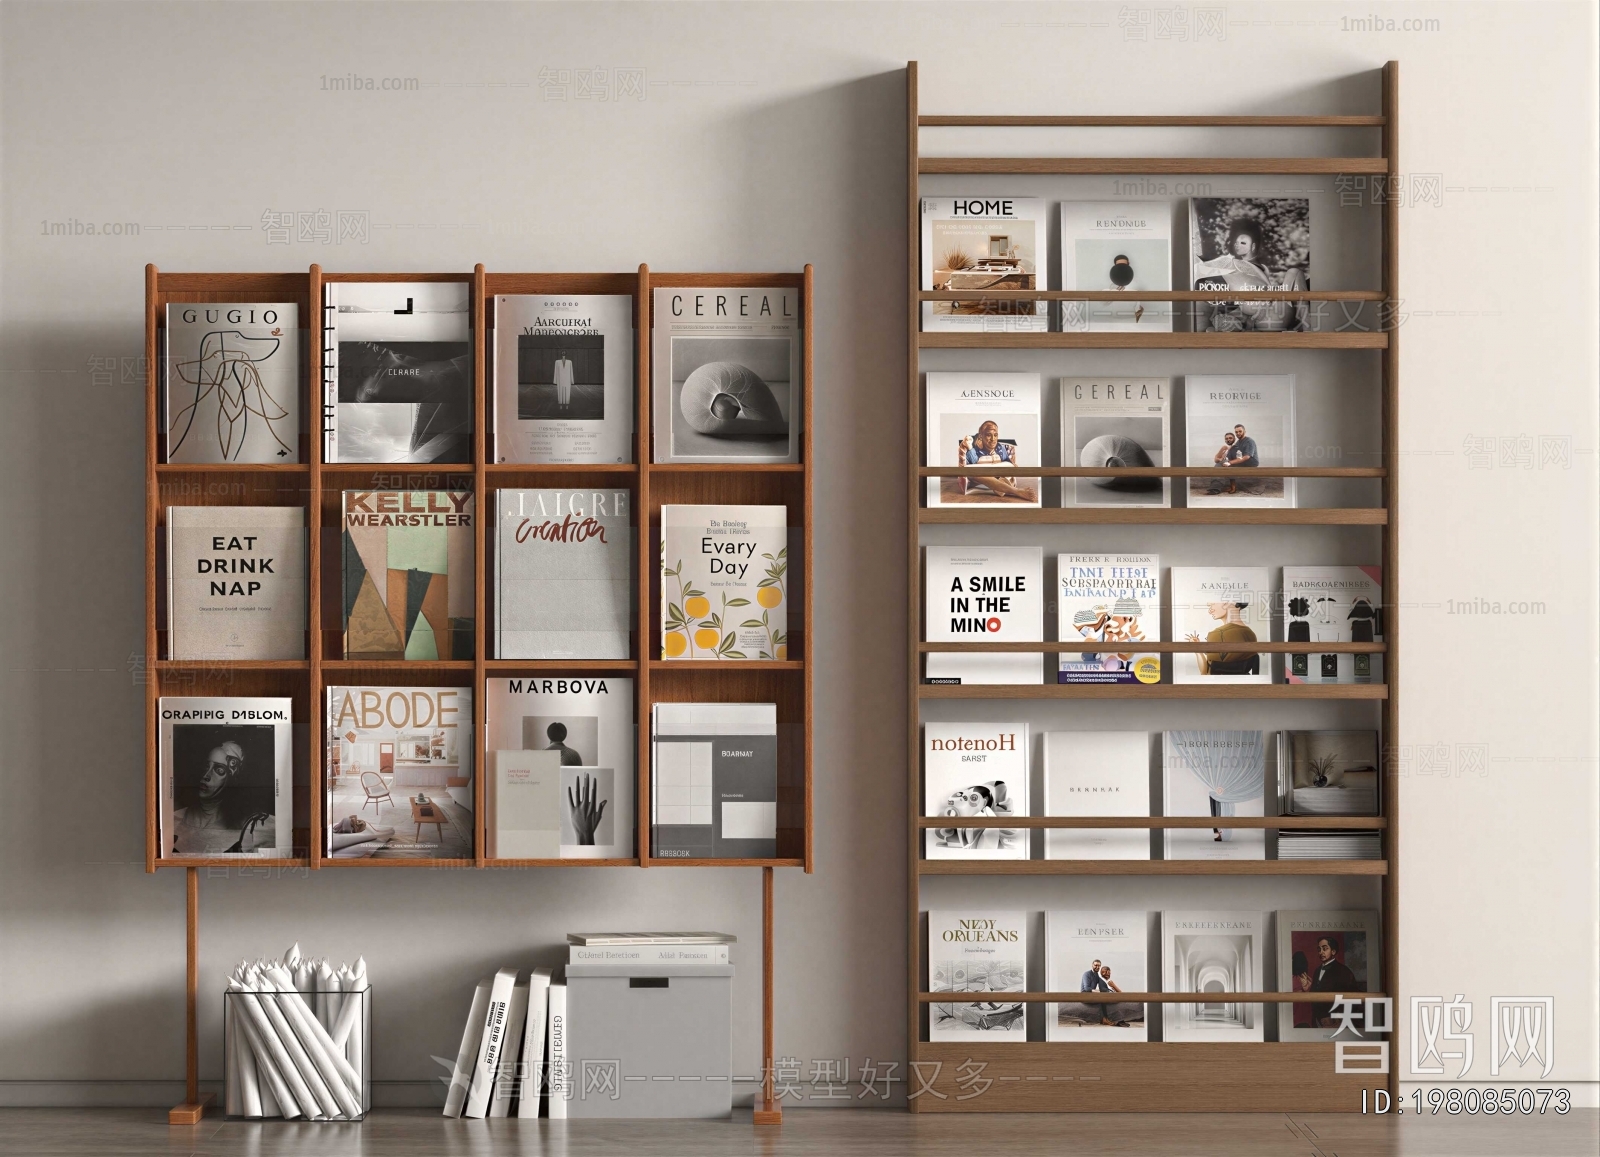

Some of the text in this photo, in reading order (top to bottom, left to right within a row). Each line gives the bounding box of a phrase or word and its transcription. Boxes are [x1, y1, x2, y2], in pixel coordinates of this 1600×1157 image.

[954, 200, 1014, 216] HOME
[672, 295, 792, 317] CEREAL
[182, 308, 279, 325] GUGIO
[346, 492, 474, 513] KELLY
[346, 514, 472, 527] WEARSTLER
[212, 537, 257, 550] EAT
[198, 559, 274, 573] DRINK
[710, 558, 749, 580] Day
[210, 581, 261, 596] NAP
[950, 576, 1026, 592] A SMILE
[950, 596, 1010, 613] IN THE
[508, 680, 609, 694] MARBOVA
[337, 691, 459, 729] ABODE
